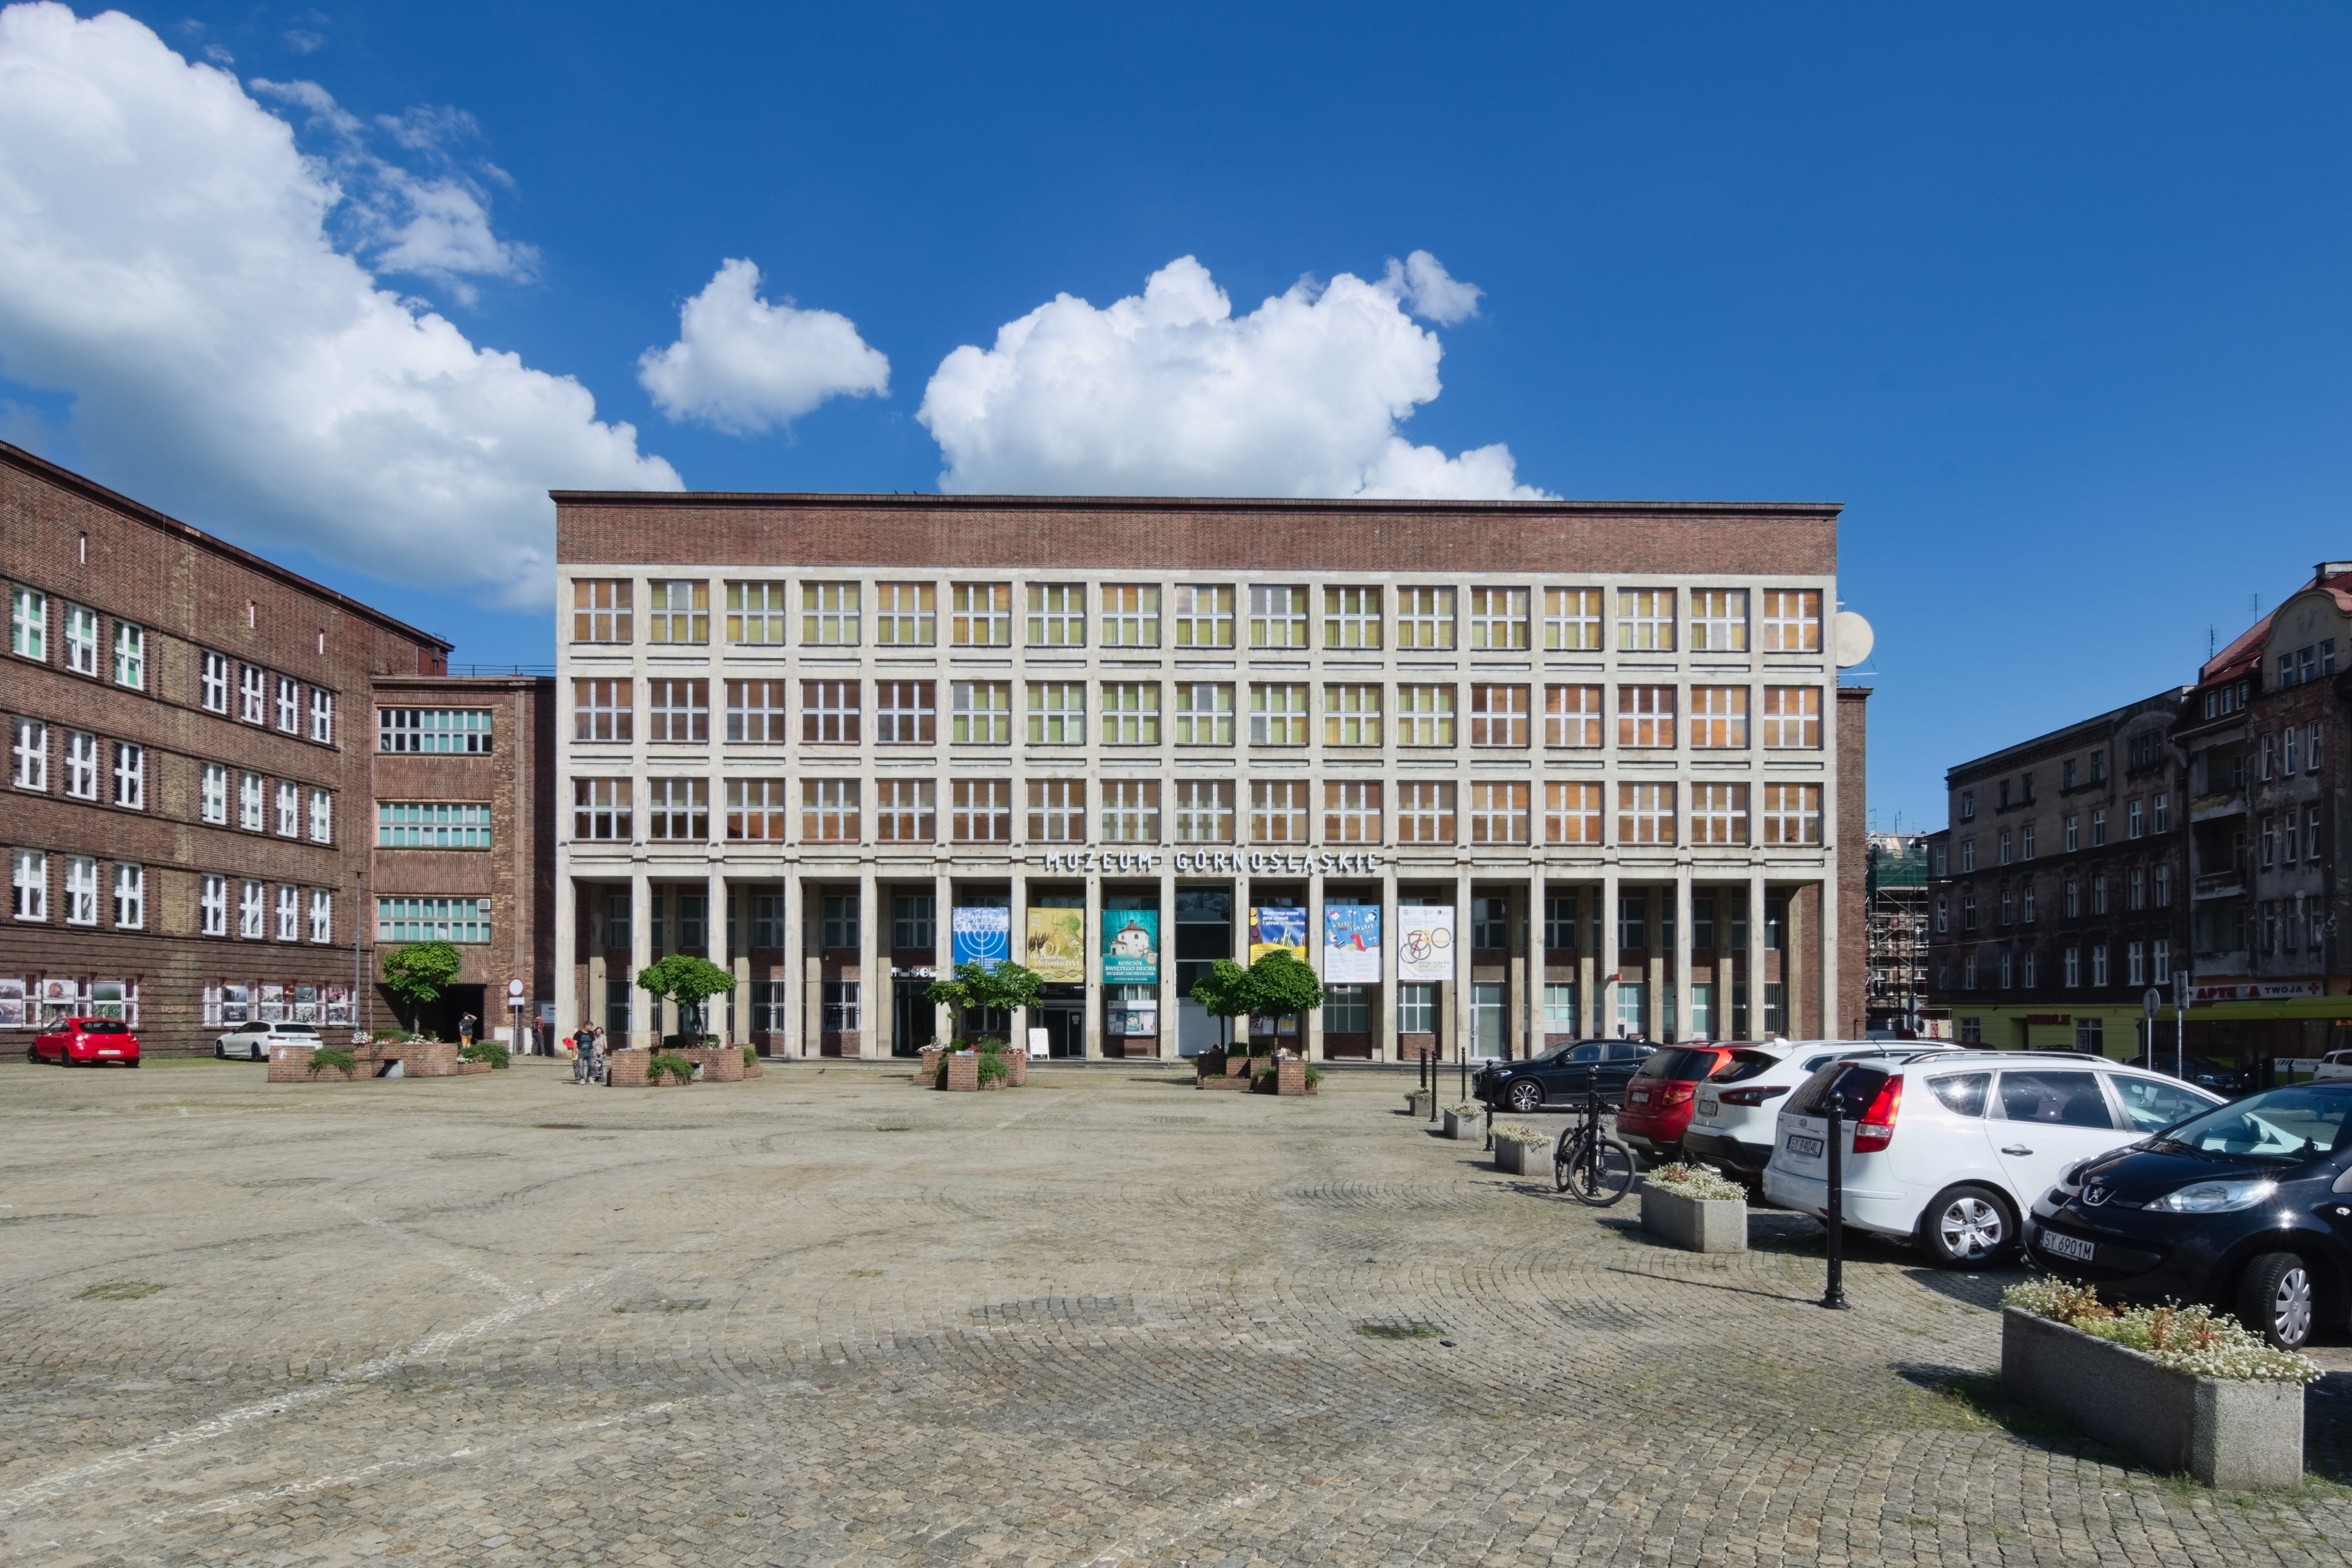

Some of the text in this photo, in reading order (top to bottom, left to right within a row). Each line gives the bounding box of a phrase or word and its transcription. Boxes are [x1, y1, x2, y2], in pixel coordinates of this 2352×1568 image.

[1045, 848, 1378, 874] MUZEUM GÓRNOŚLĄSKIE
[2197, 986, 2303, 998] APTEKA TWOJA
[1790, 1138, 1818, 1154] SY 9404L
[2045, 1233, 2057, 1249] SY
[2059, 1237, 2092, 1259] 6901M
